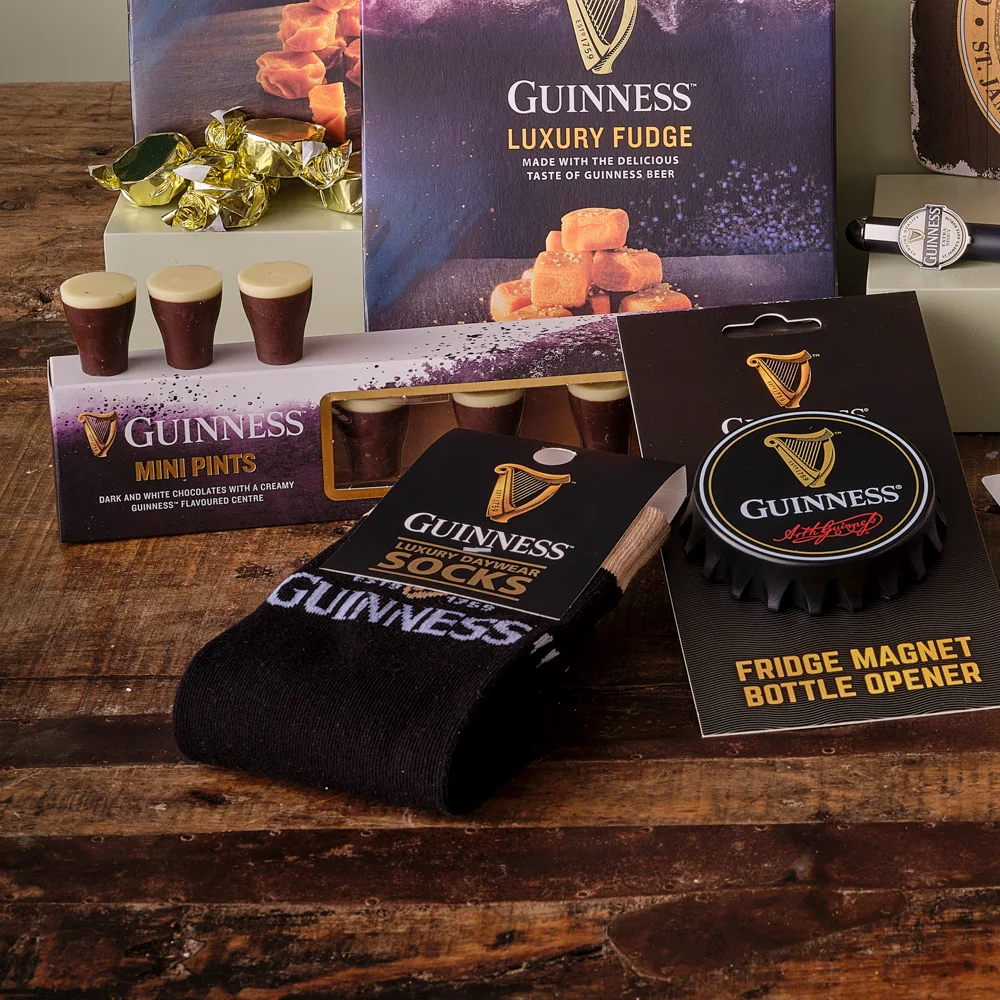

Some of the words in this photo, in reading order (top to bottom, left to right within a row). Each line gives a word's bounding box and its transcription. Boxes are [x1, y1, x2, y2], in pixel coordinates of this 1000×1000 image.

[581, 37, 594, 60] 1759
[508, 127, 604, 150] LUXURY
[613, 126, 693, 148] FUDGE
[522, 158, 556, 167] MADE
[558, 157, 588, 166] WITH
[592, 156, 614, 166] THE
[618, 156, 679, 166] DELICIOUS
[527, 172, 562, 181] TASTE
[565, 171, 581, 180] OF
[584, 170, 643, 180] GUINNESS
[646, 170, 675, 179] BEER
[924, 207, 940, 266] GUINNESS
[135, 457, 186, 482] MINI
[192, 453, 257, 477] PINTS
[99, 494, 122, 504] DARK
[124, 493, 141, 502] AND
[143, 491, 171, 500] WHITE
[172, 486, 227, 499] CHOCOLATES
[228, 484, 251, 493] WITH
[252, 483, 259, 492] A
[260, 481, 295, 491] CREAMY
[181, 497, 230, 508] FLAVOURED
[231, 494, 264, 504] CENTRE
[377, 551, 534, 596] SOCKS
[395, 542, 458, 560] LUXURY
[460, 555, 540, 578] DAYWEAR
[267, 571, 533, 646] GUINNESS
[736, 650, 843, 682] FRIDGE
[850, 636, 973, 670] MAGNET
[744, 677, 857, 707] BOTTLE
[864, 661, 982, 695] OPENER
